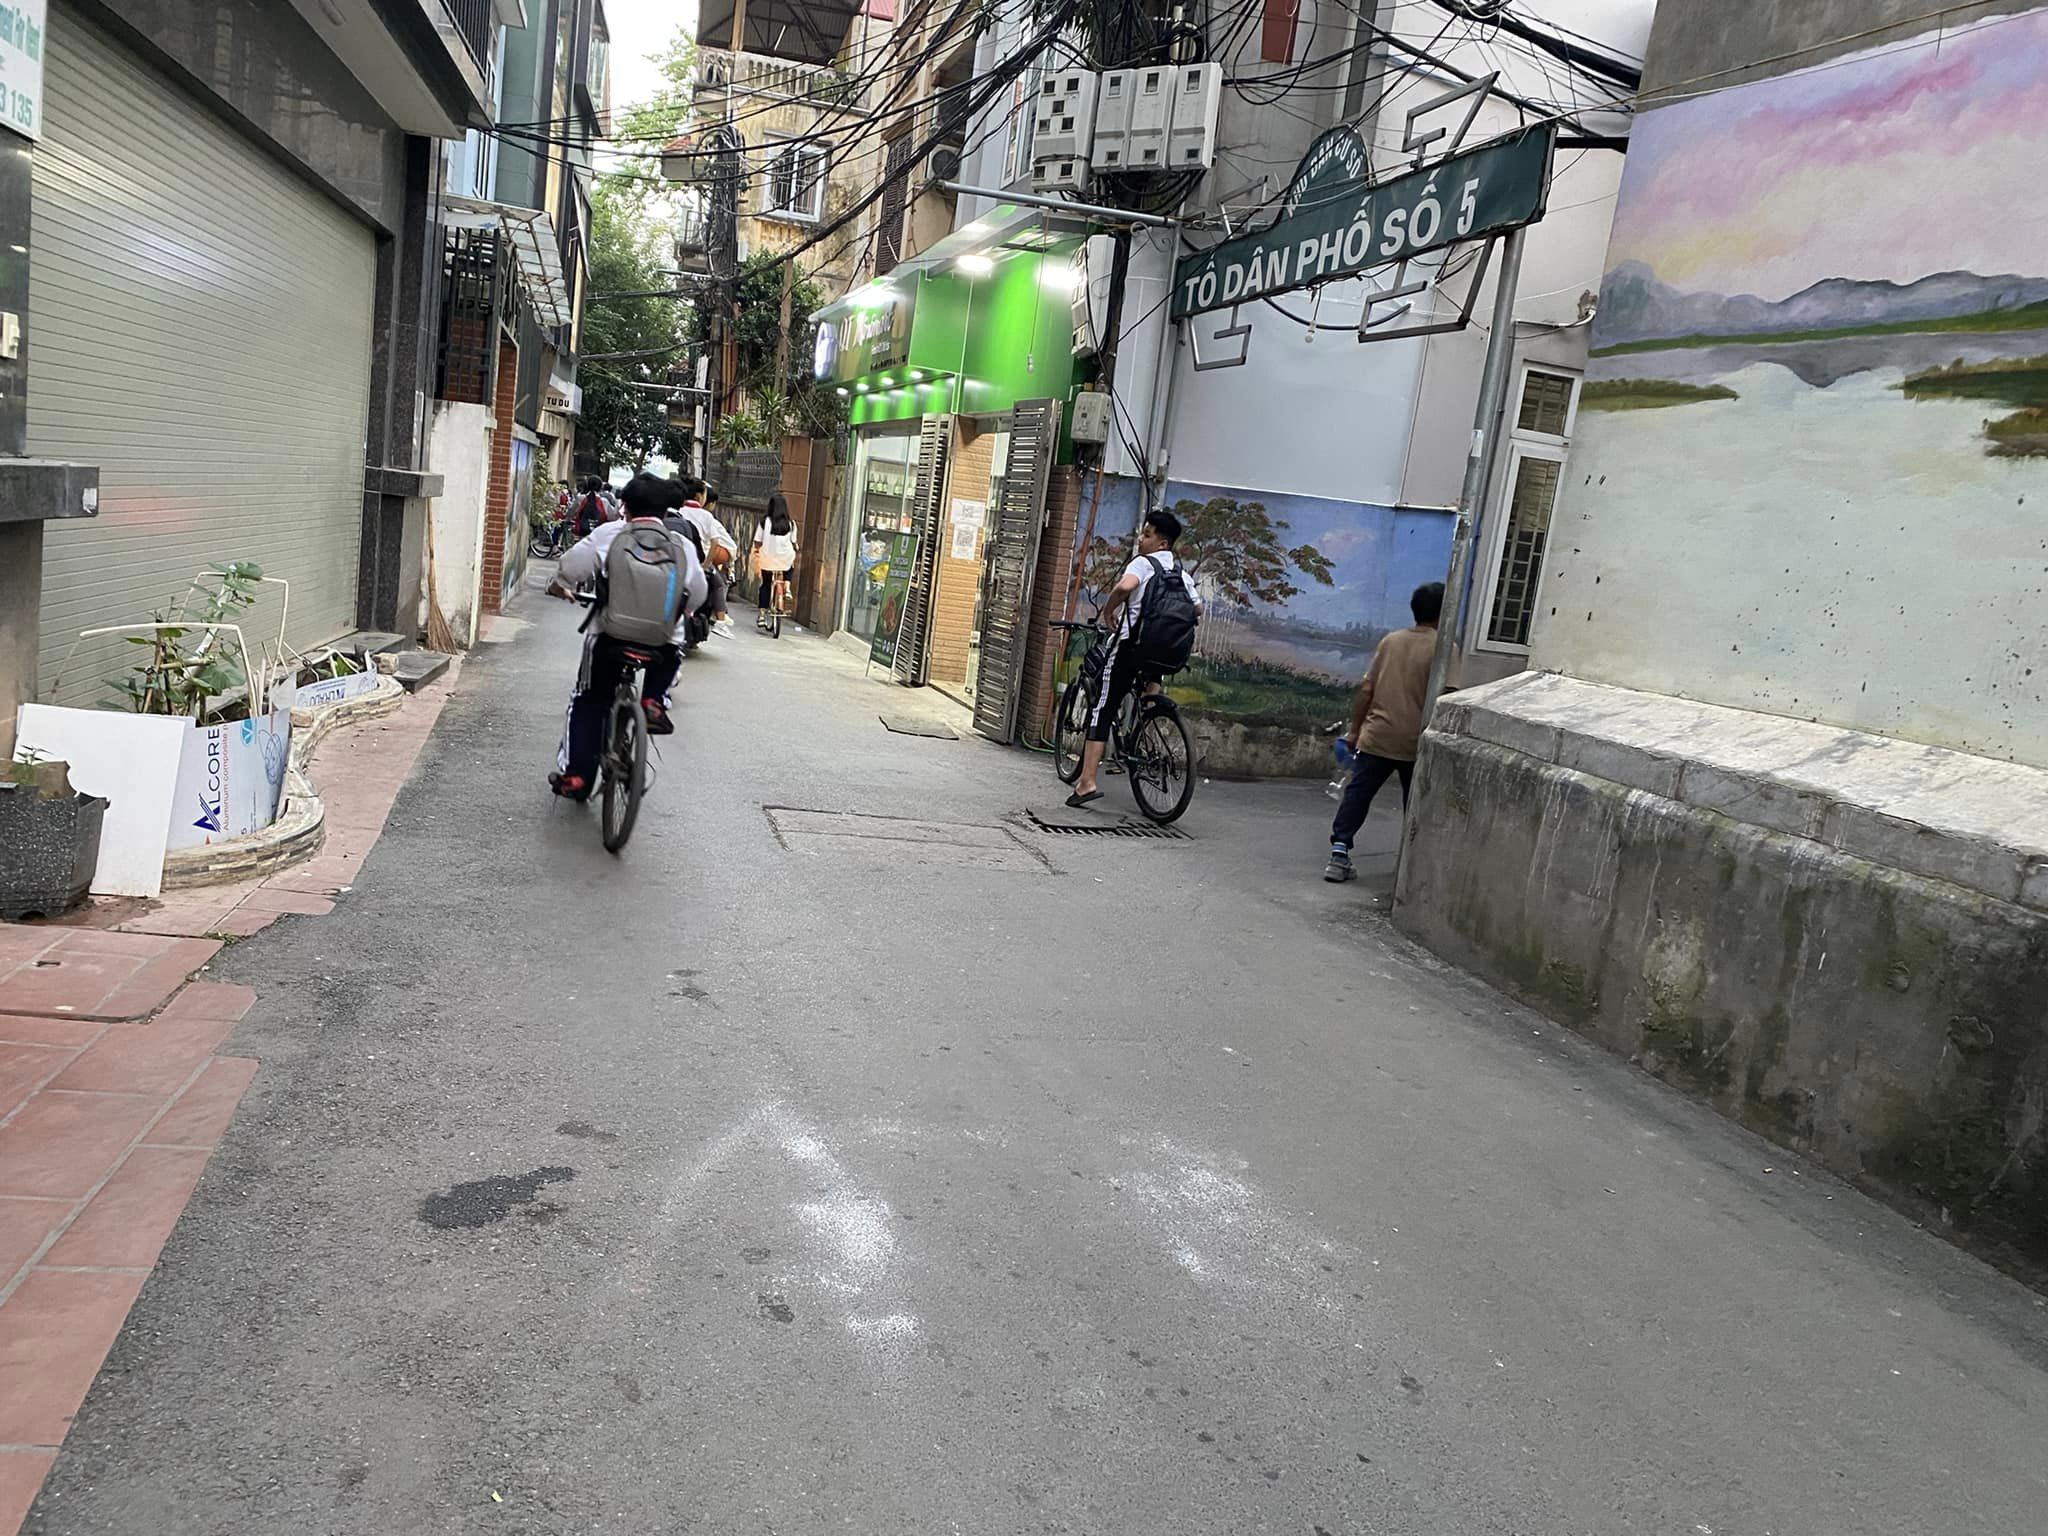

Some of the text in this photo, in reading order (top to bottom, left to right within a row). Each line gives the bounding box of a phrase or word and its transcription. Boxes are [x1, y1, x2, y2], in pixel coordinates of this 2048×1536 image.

[11, 89, 33, 127] 135
[1222, 246, 1290, 301] DÂN
[1295, 195, 1372, 280] PHỐ
[1380, 168, 1442, 256] SỐ
[1457, 178, 1480, 236] 5
